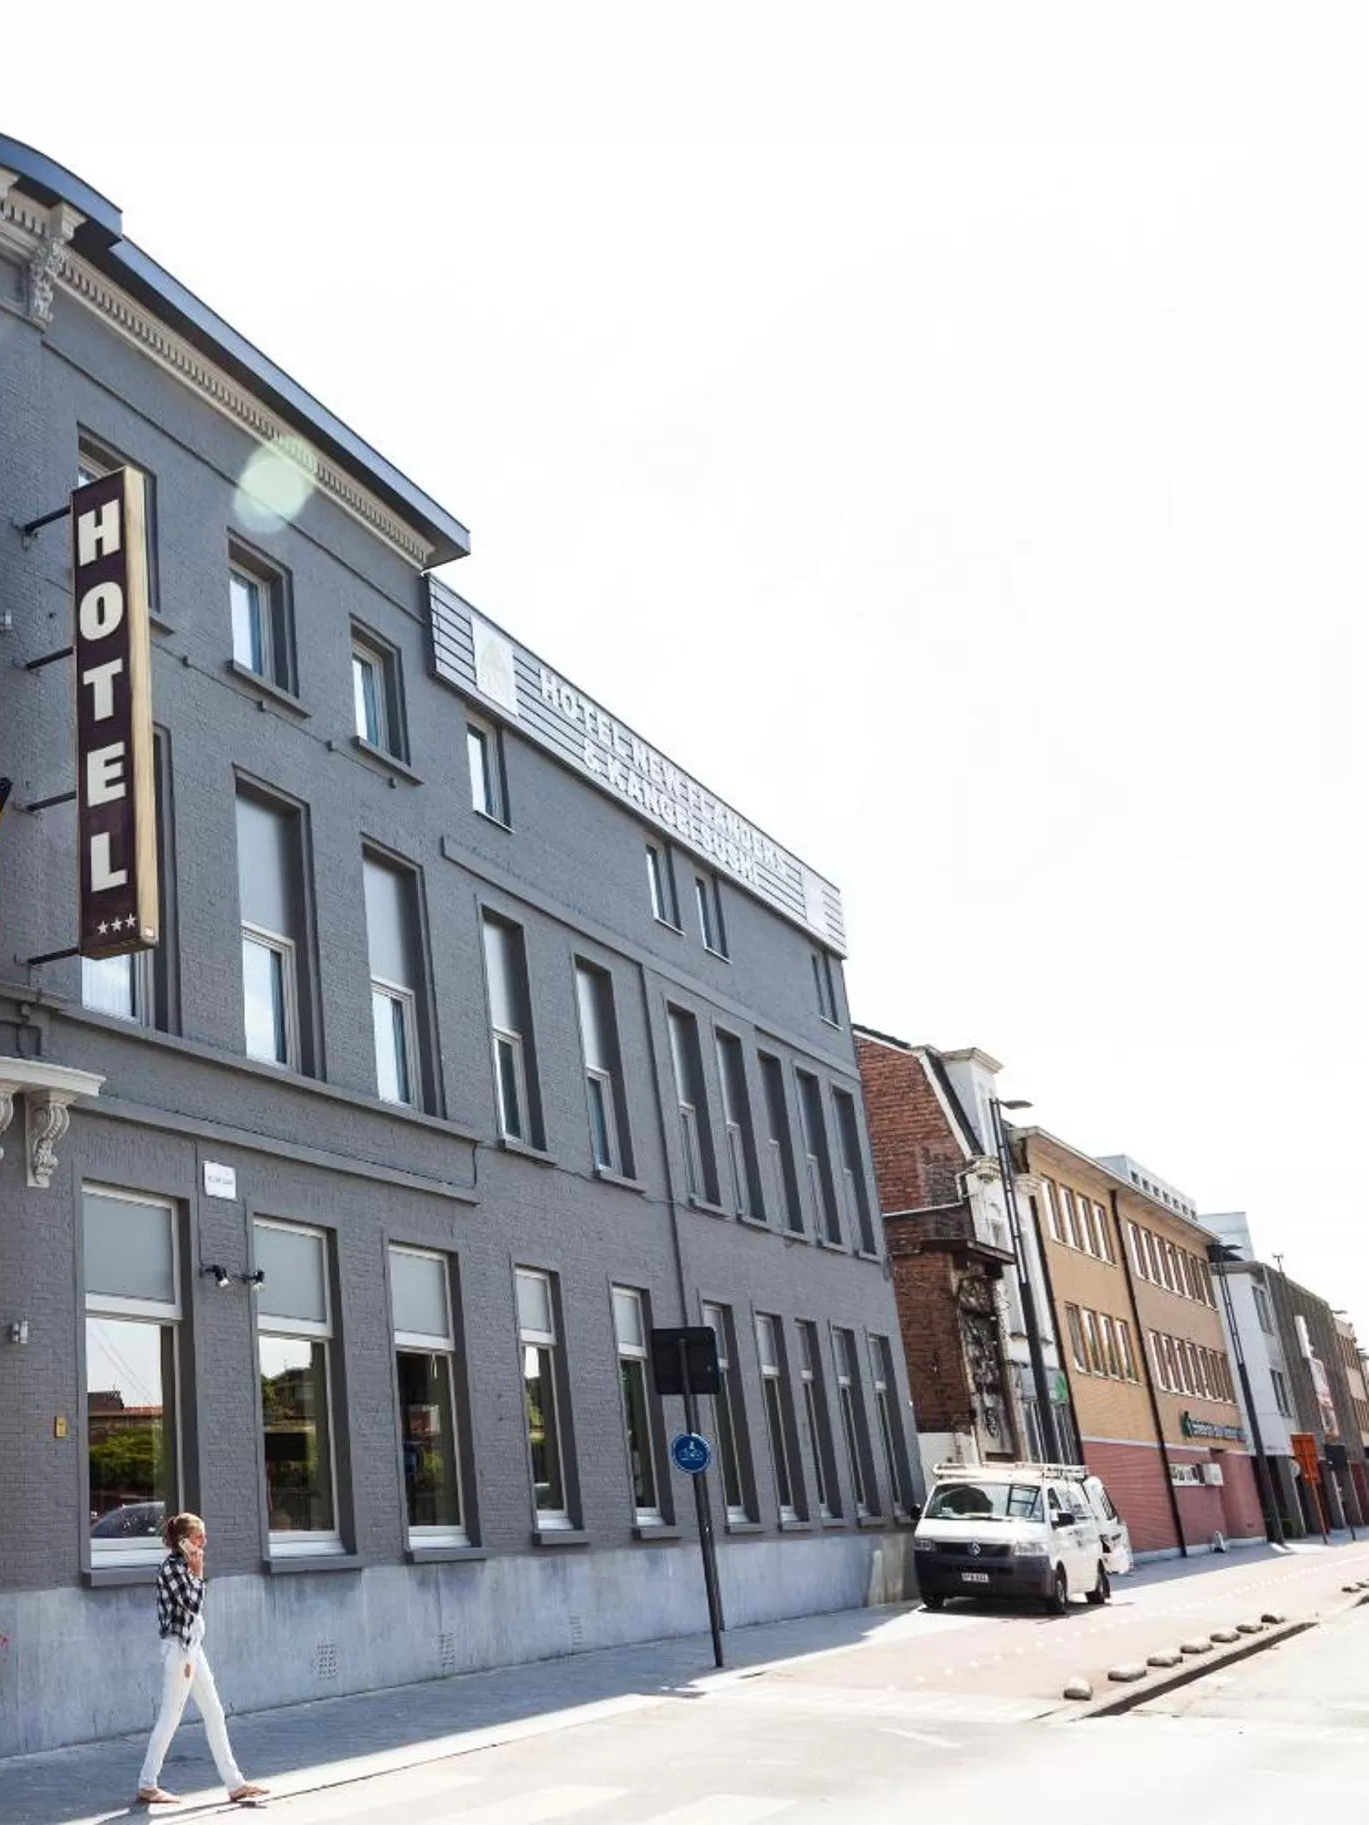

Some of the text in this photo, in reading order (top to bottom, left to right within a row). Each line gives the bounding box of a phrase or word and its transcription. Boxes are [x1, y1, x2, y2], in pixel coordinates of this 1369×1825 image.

[77, 499, 128, 893] HOTEL
[538, 665, 786, 878] HOTEL NEW FLANDERS
[582, 734, 601, 776] &
[700, 819, 758, 886] SUSHI
